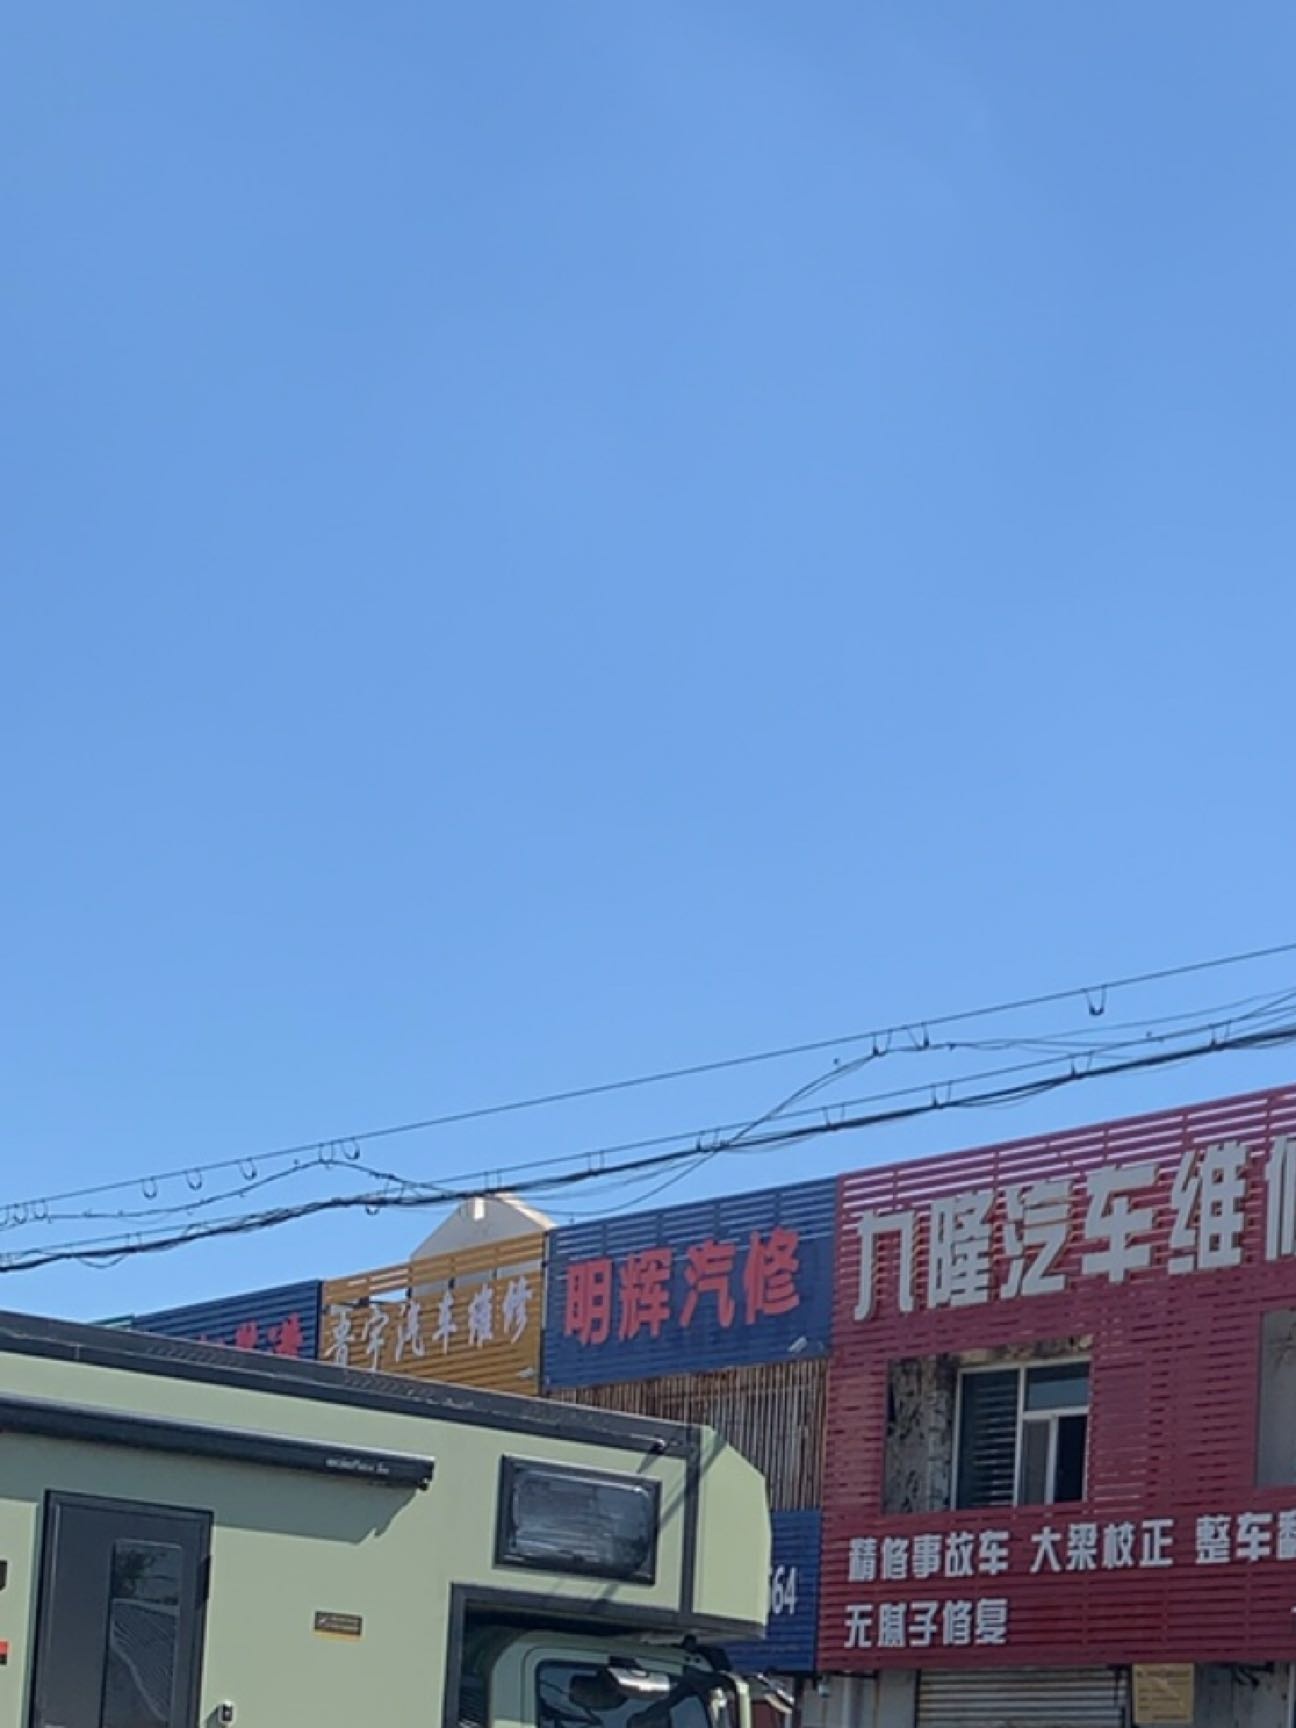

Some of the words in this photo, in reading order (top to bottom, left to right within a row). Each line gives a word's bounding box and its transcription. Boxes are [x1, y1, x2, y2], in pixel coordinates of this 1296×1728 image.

[564, 1227, 799, 1346] 明辉汽修
[848, 1531, 1009, 1583] 精修事故车
[1029, 1518, 1174, 1573] 大梁校正
[844, 1598, 1009, 1648] 无腻子修复
